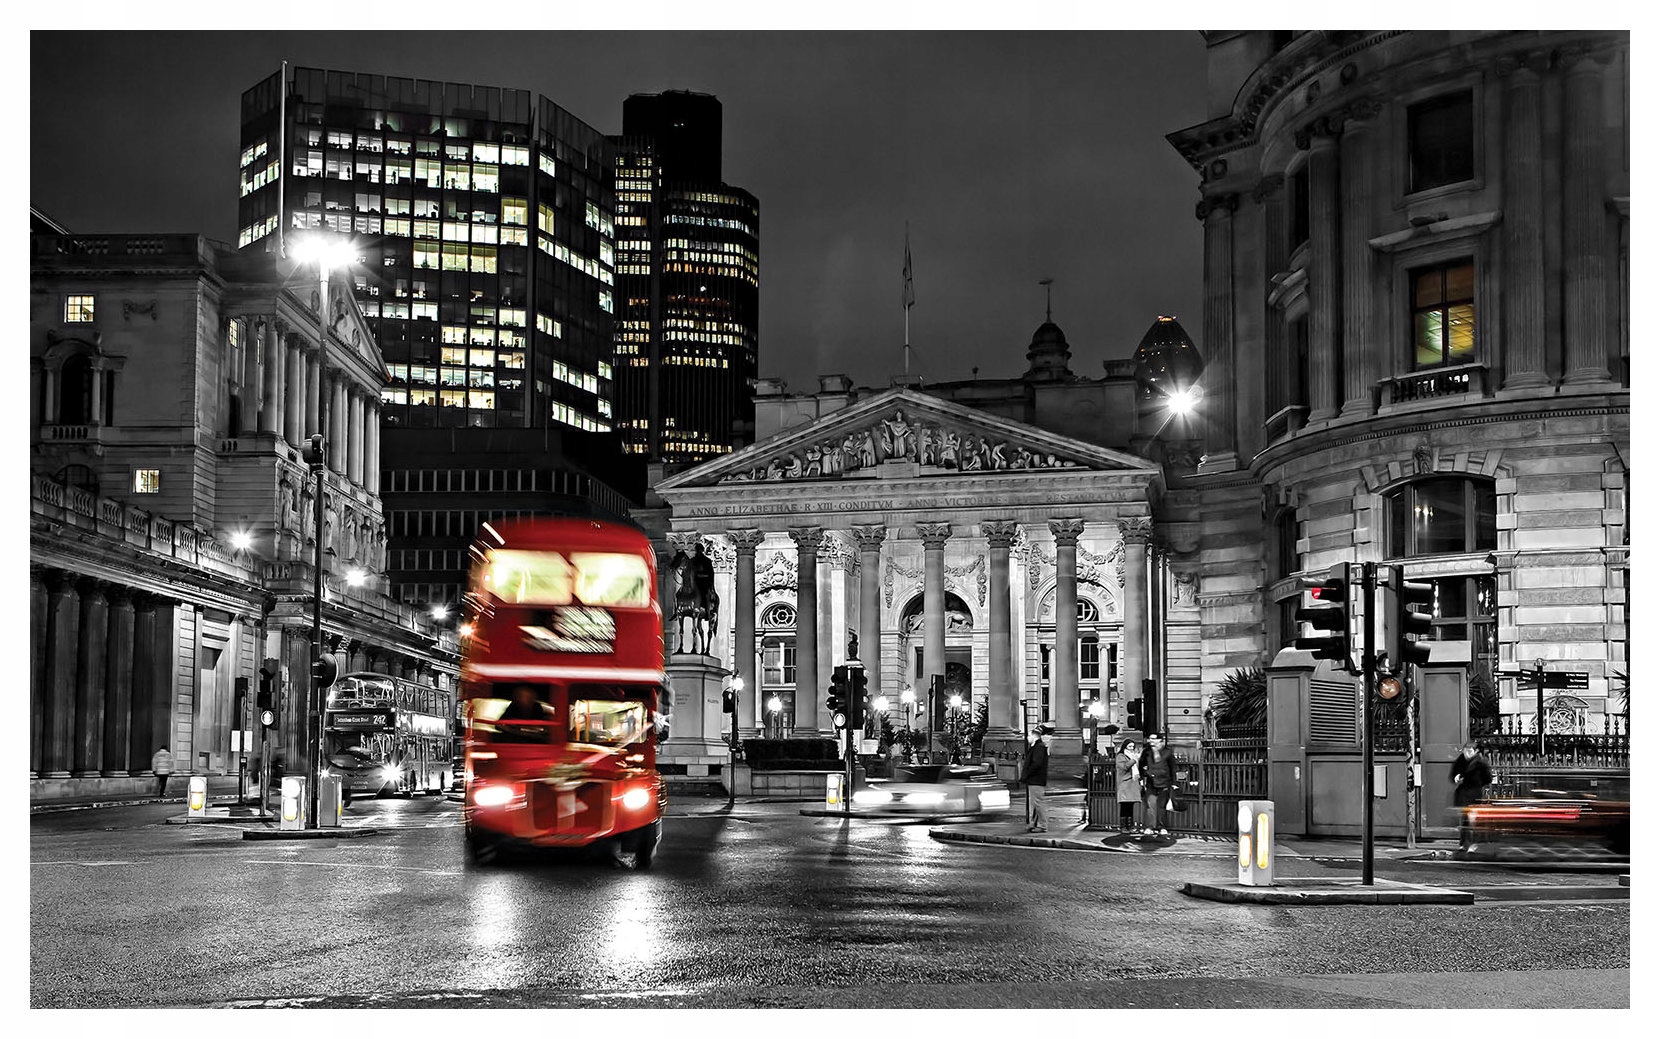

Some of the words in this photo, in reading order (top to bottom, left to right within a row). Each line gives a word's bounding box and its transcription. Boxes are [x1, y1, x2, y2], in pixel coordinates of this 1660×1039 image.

[689, 507, 718, 516] ANNO
[725, 503, 798, 515] ELIZABETHAE
[838, 500, 894, 511] CONDITVM
[908, 497, 937, 508] ANNO
[373, 715, 386, 725] 242
